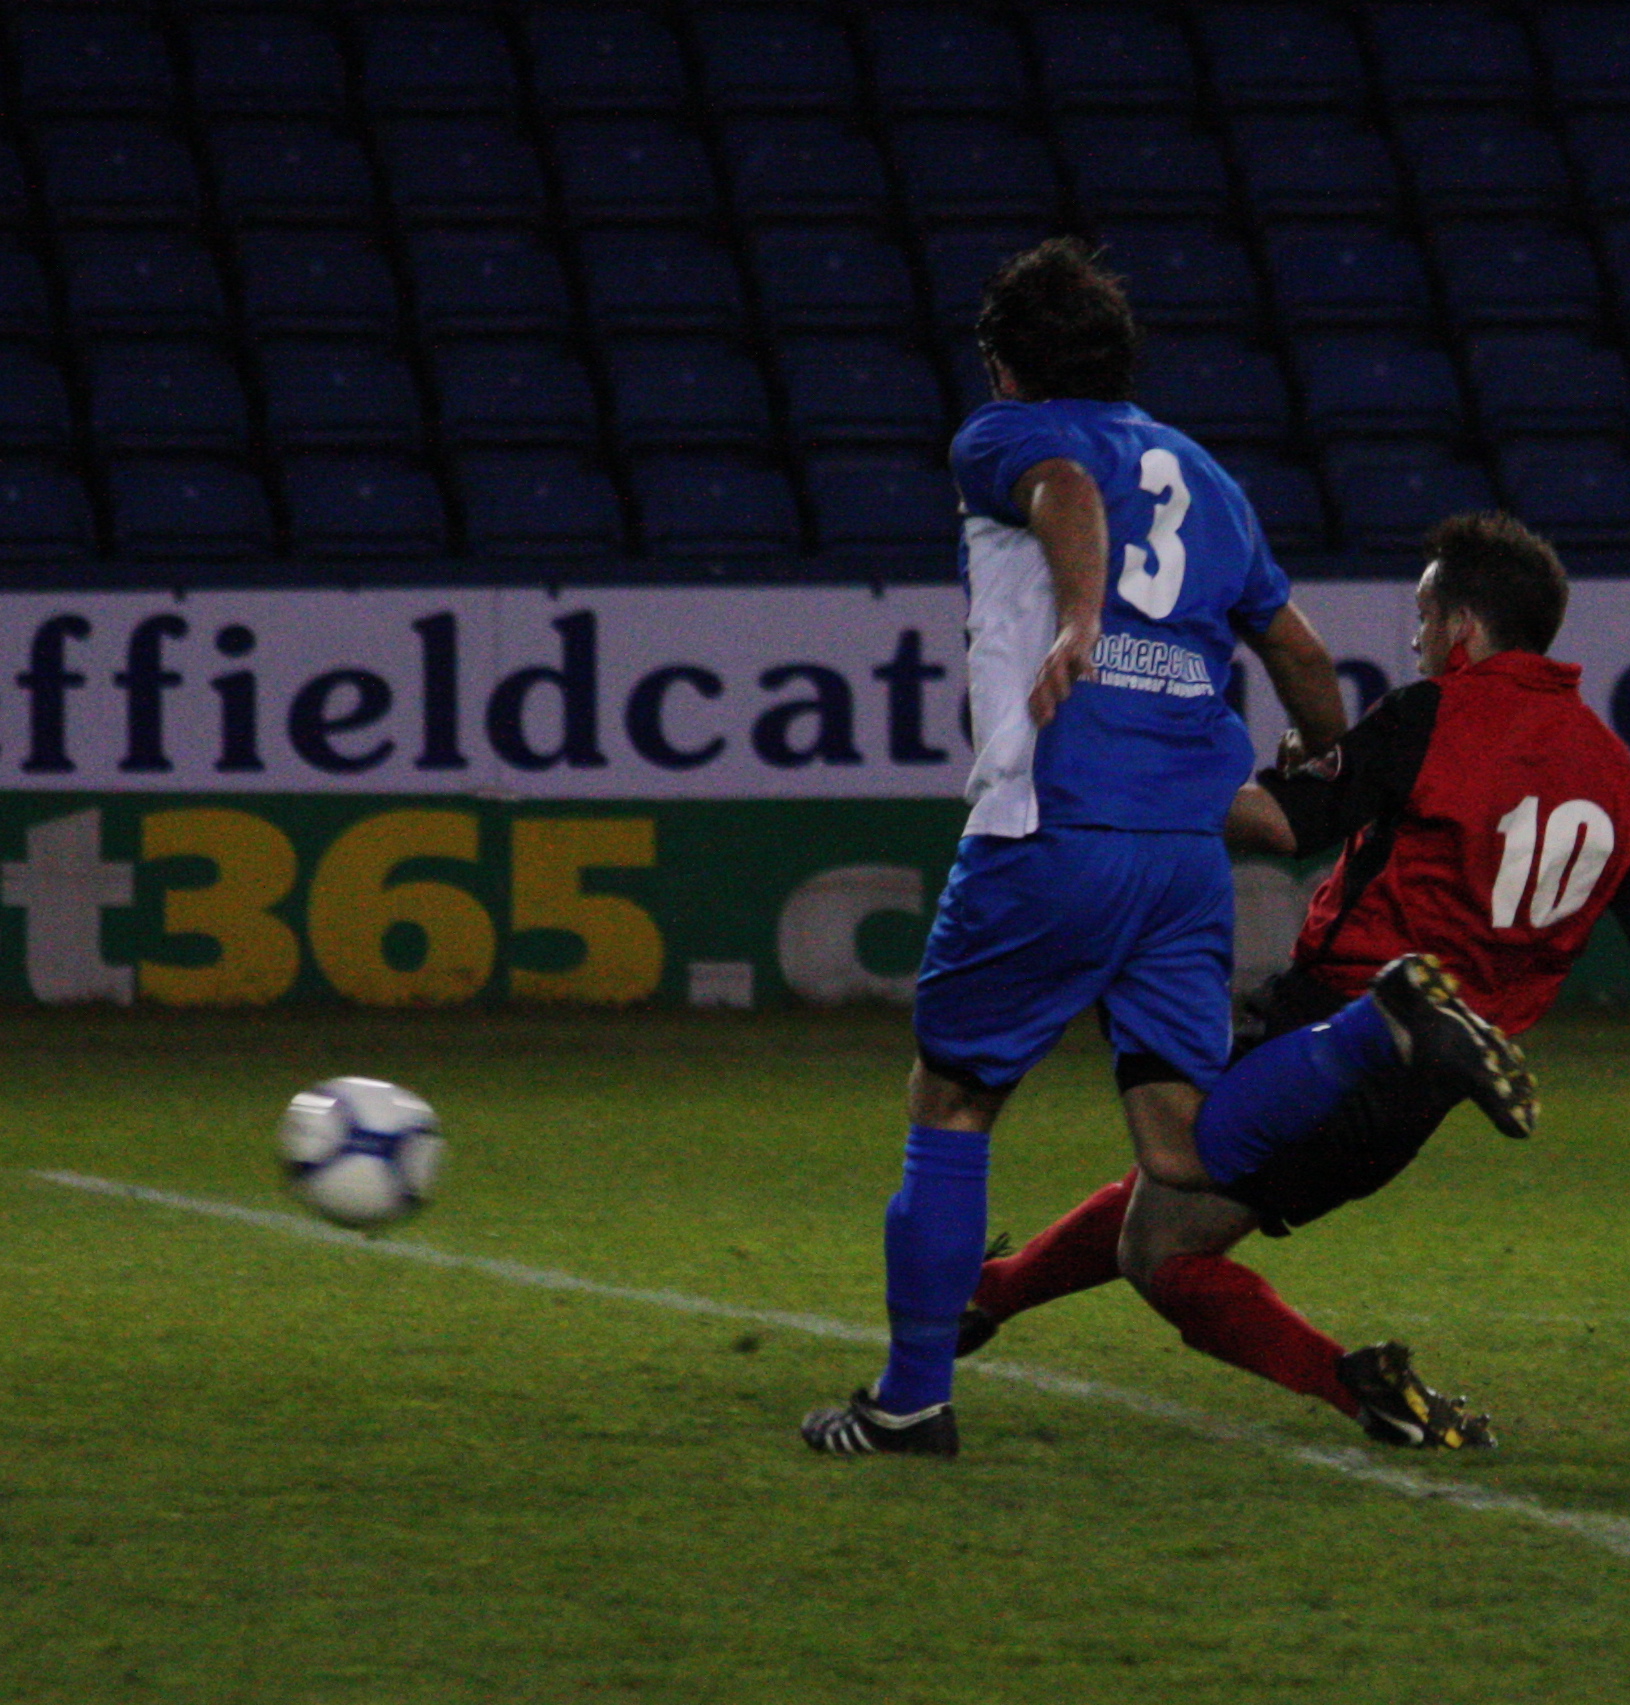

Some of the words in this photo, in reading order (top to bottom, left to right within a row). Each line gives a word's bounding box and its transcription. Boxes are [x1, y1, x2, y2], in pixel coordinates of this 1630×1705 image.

[1116, 448, 1192, 620] 3
[17, 609, 976, 776] ffieldcat
[0, 806, 928, 1008] t365.c
[1491, 795, 1615, 929] 10
